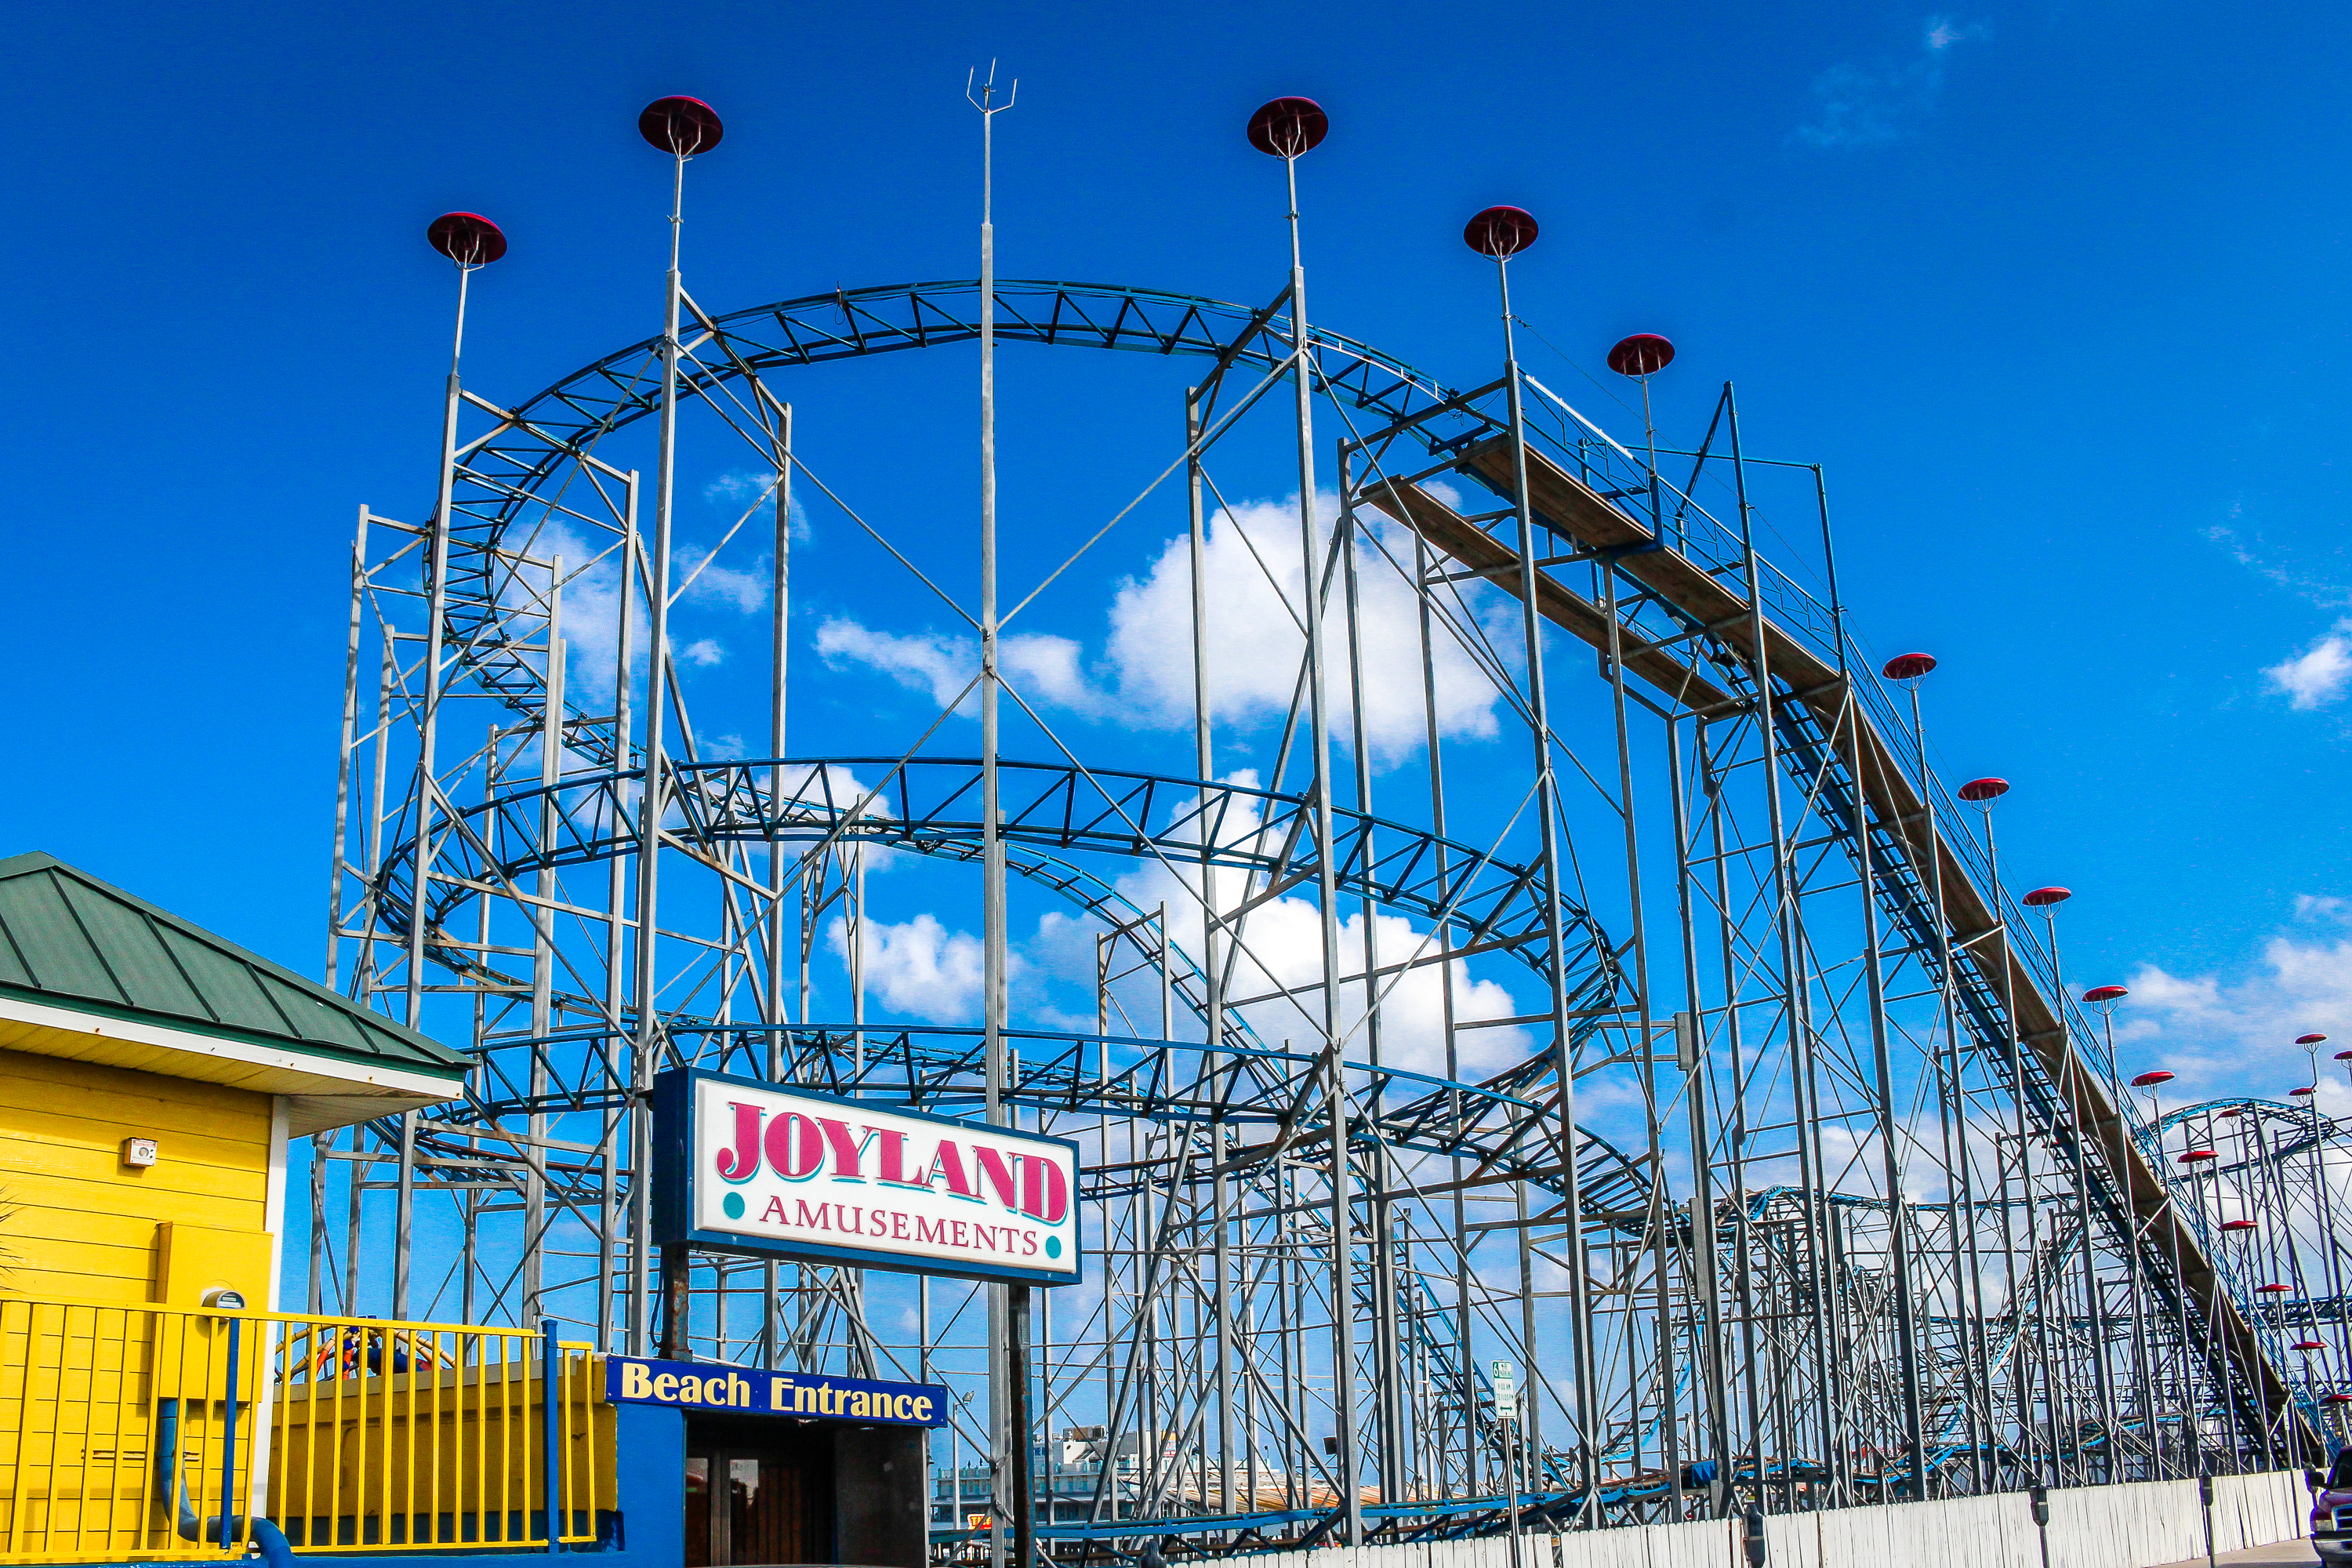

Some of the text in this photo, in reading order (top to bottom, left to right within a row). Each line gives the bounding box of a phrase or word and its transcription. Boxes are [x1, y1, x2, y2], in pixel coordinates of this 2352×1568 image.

[716, 1101, 1069, 1225] JOYLAND
[758, 1195, 1038, 1257] AMUSEMENTS
[622, 1362, 933, 1421] Beach Entrance
[1494, 1363, 1499, 1377] 6
